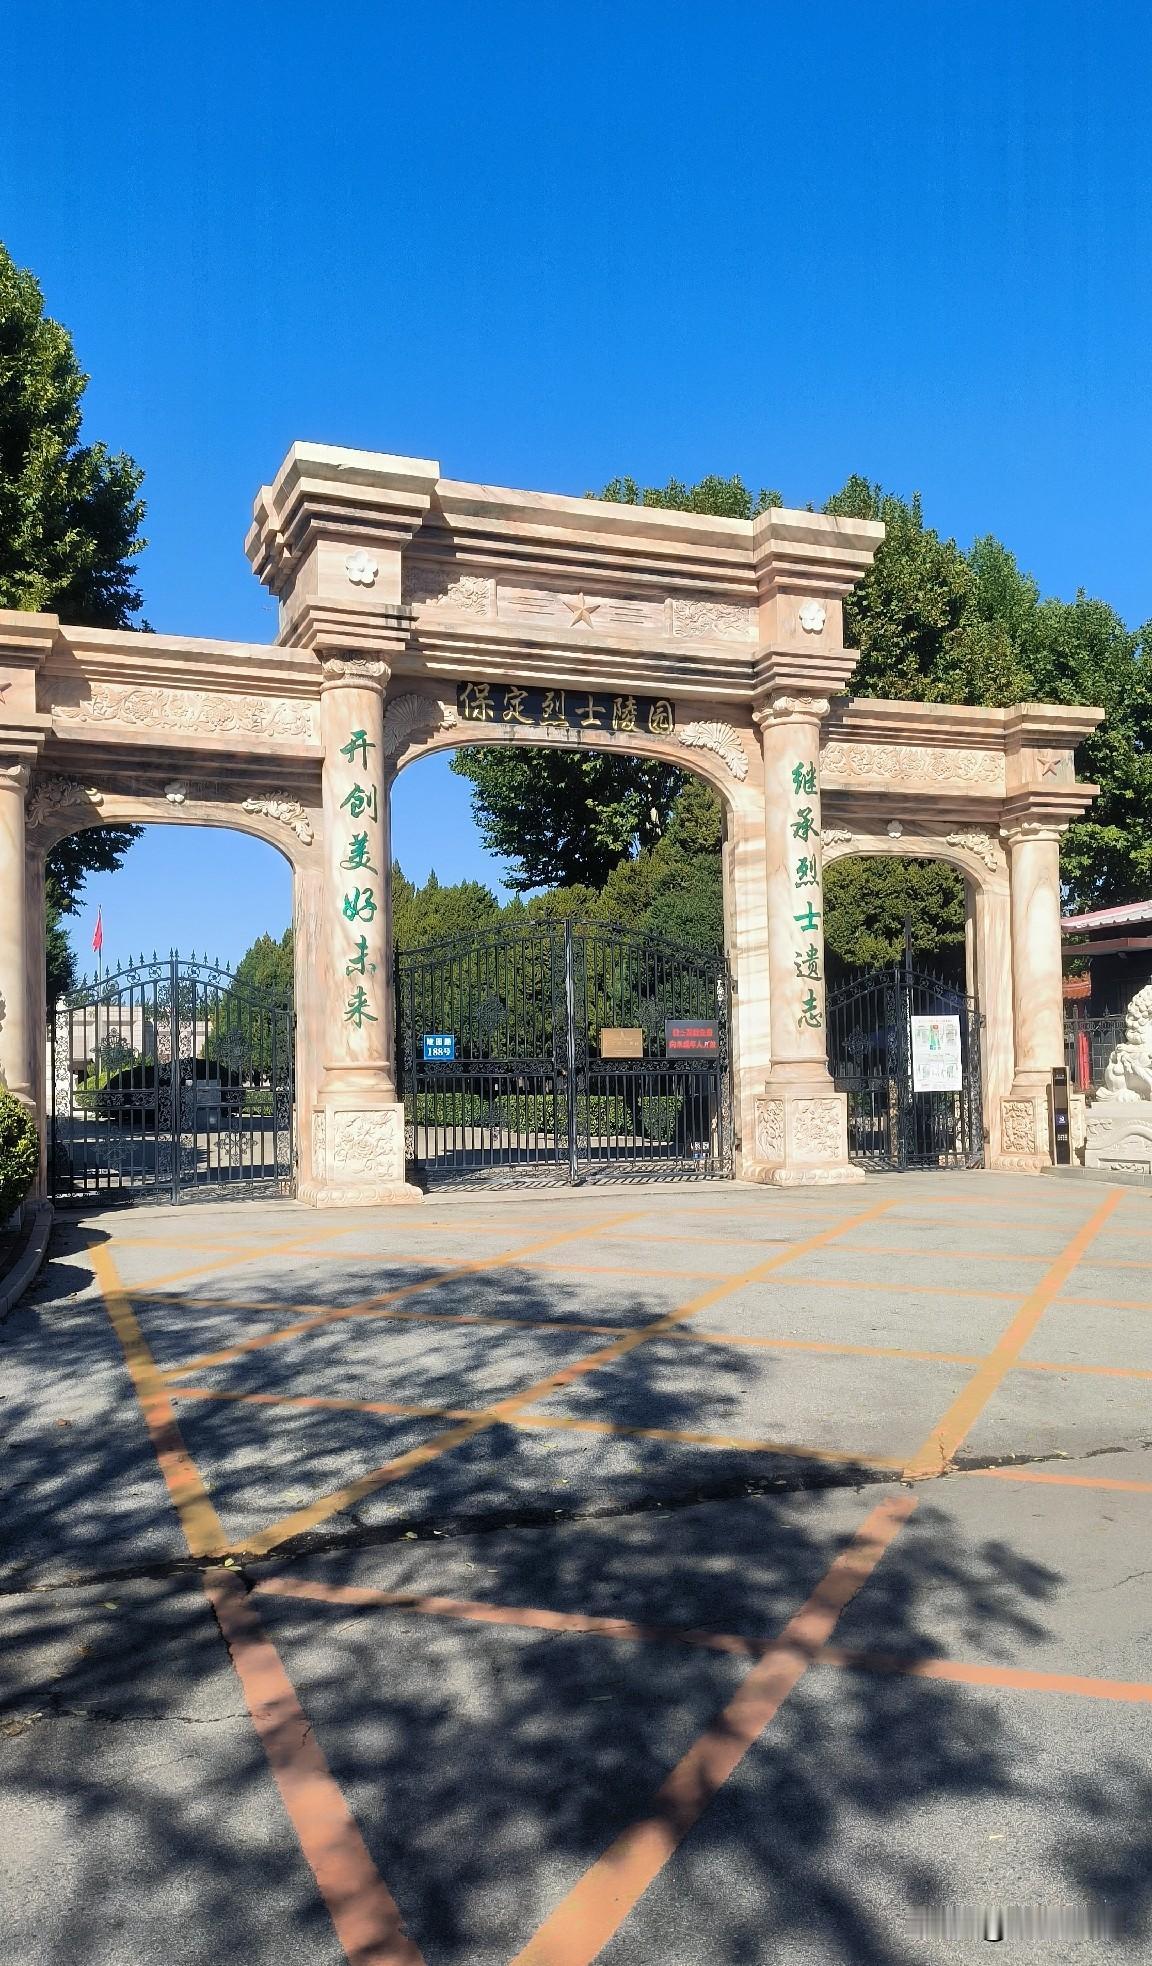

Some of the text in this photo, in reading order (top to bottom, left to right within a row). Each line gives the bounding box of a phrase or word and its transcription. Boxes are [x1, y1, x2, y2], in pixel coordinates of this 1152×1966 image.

[460, 683, 673, 734] 保定烈士陵园
[339, 729, 378, 1028] 开创美好未来
[790, 761, 822, 1029] 继承烈士遗志
[427, 1047, 451, 1057] 188号
